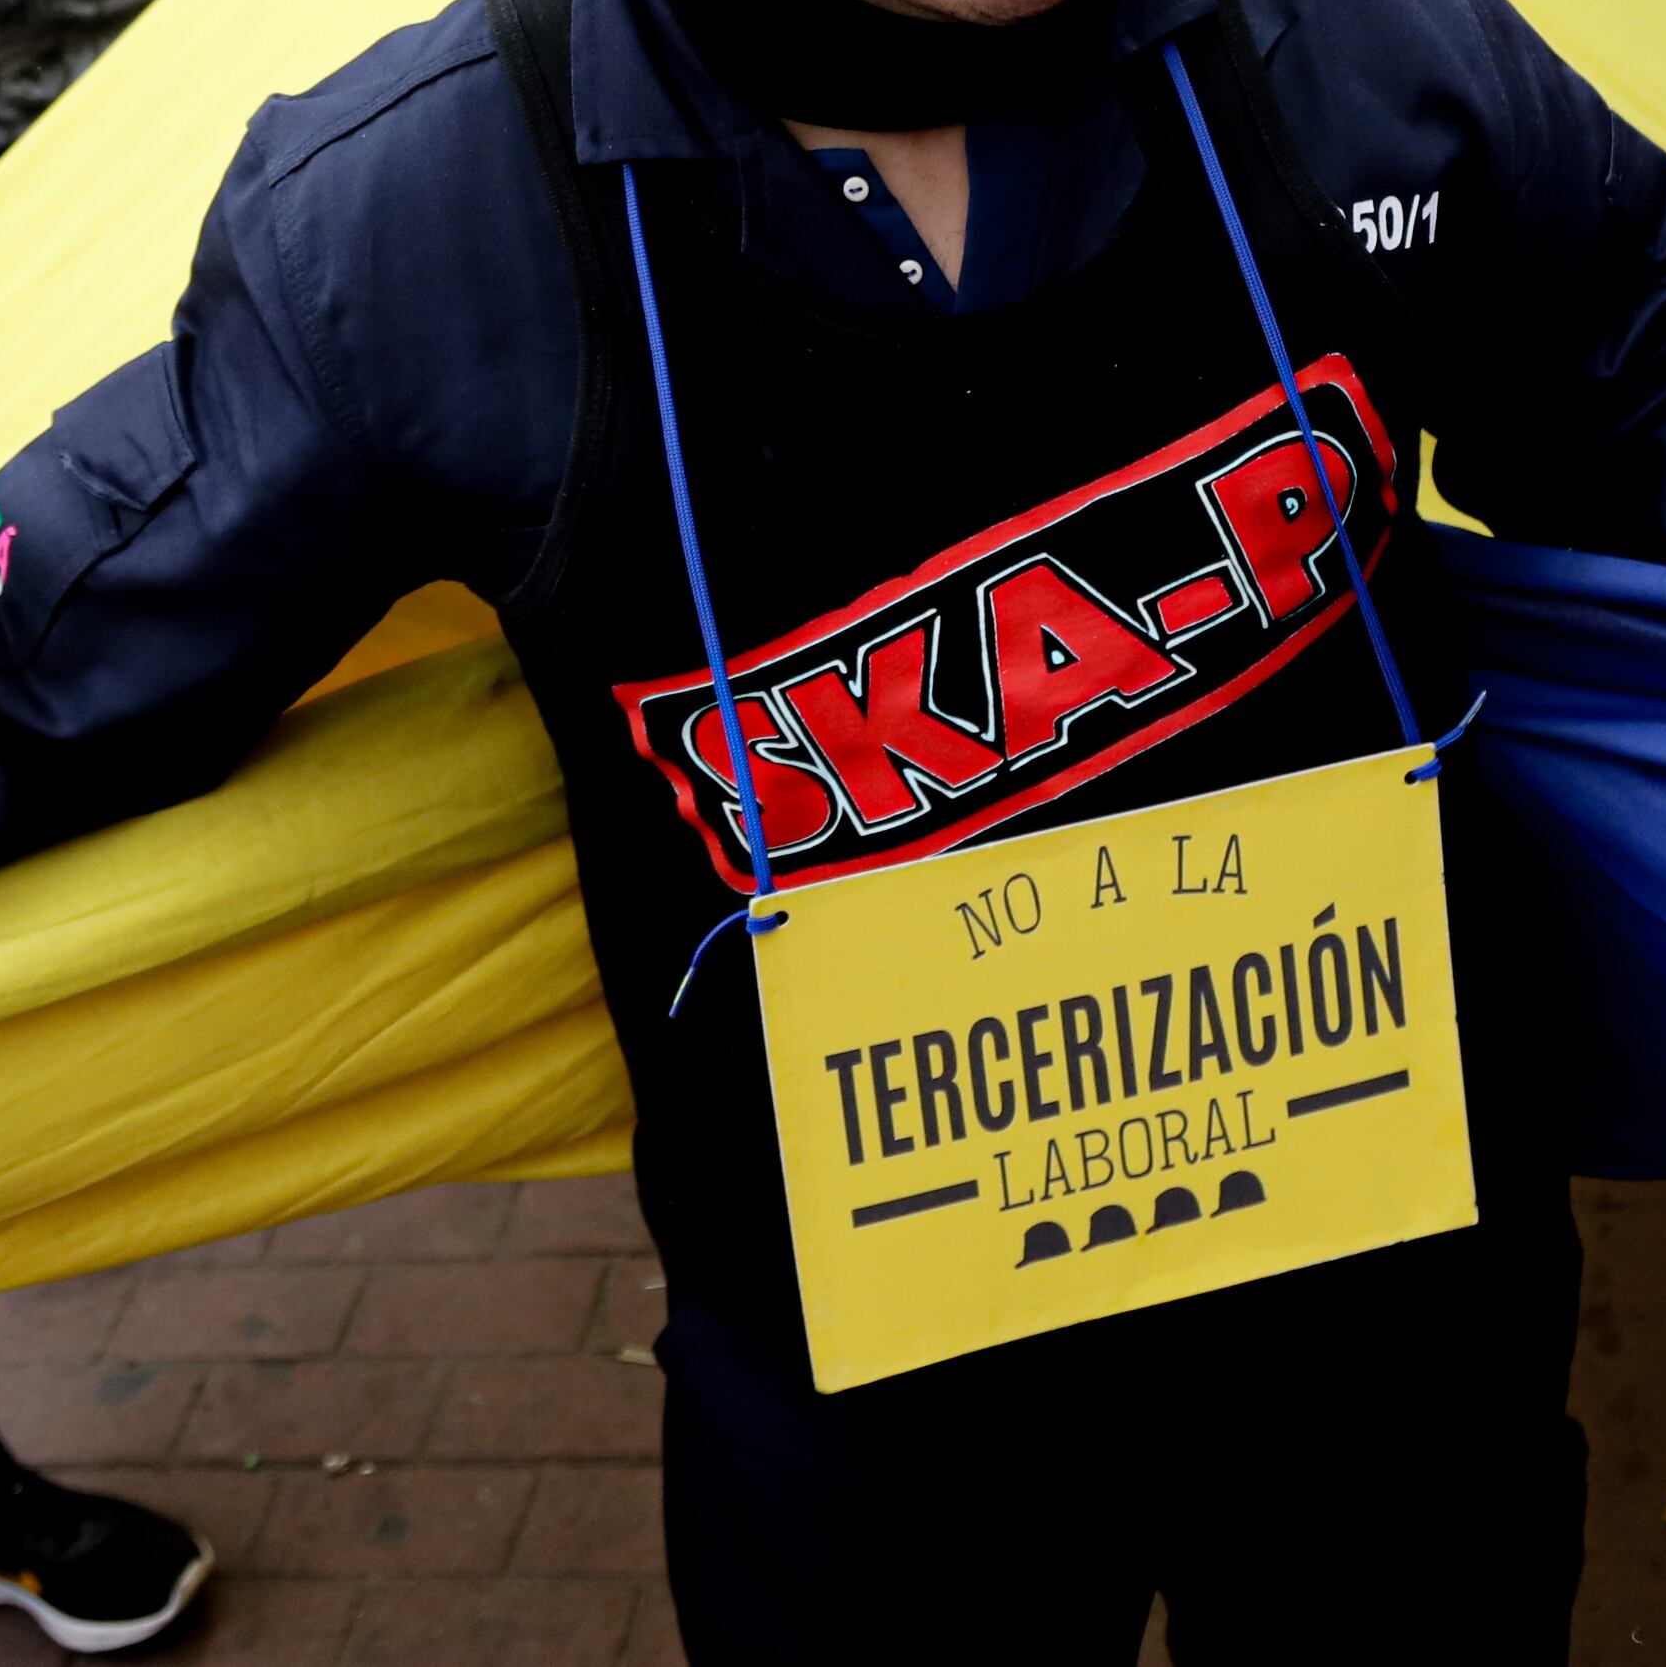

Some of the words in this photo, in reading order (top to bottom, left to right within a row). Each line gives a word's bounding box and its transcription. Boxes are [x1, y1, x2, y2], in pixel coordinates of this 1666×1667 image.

[1335, 191, 1440, 254] 50/1
[681, 430, 1358, 857] SKA-P
[954, 872, 1043, 960] NO
[1089, 845, 1128, 910] A
[1170, 833, 1249, 896] LA
[824, 901, 1407, 1166] TERCERIZACIÓN
[993, 1089, 1277, 1212] LABORAL
